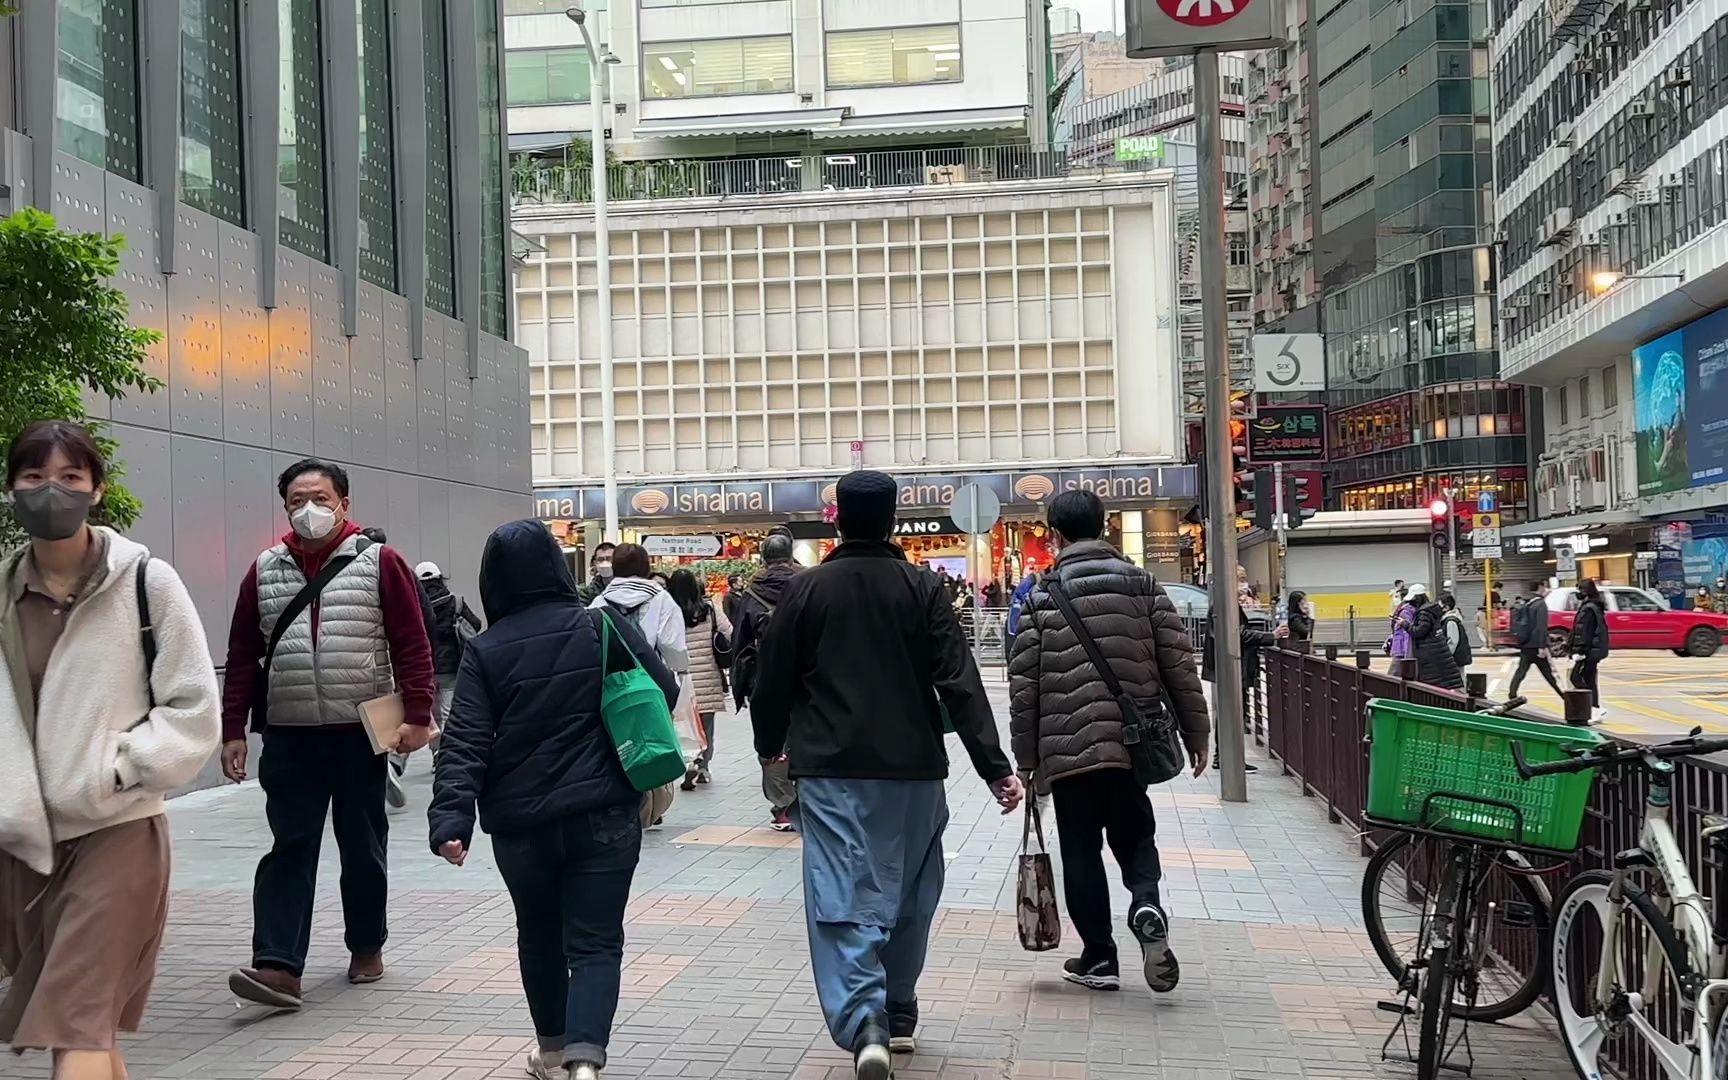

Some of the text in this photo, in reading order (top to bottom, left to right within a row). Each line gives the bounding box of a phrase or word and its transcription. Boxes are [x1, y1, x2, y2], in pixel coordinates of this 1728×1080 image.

[1266, 335, 1301, 386] 6
[1065, 473, 1152, 497] shama
[679, 487, 763, 514] shama
